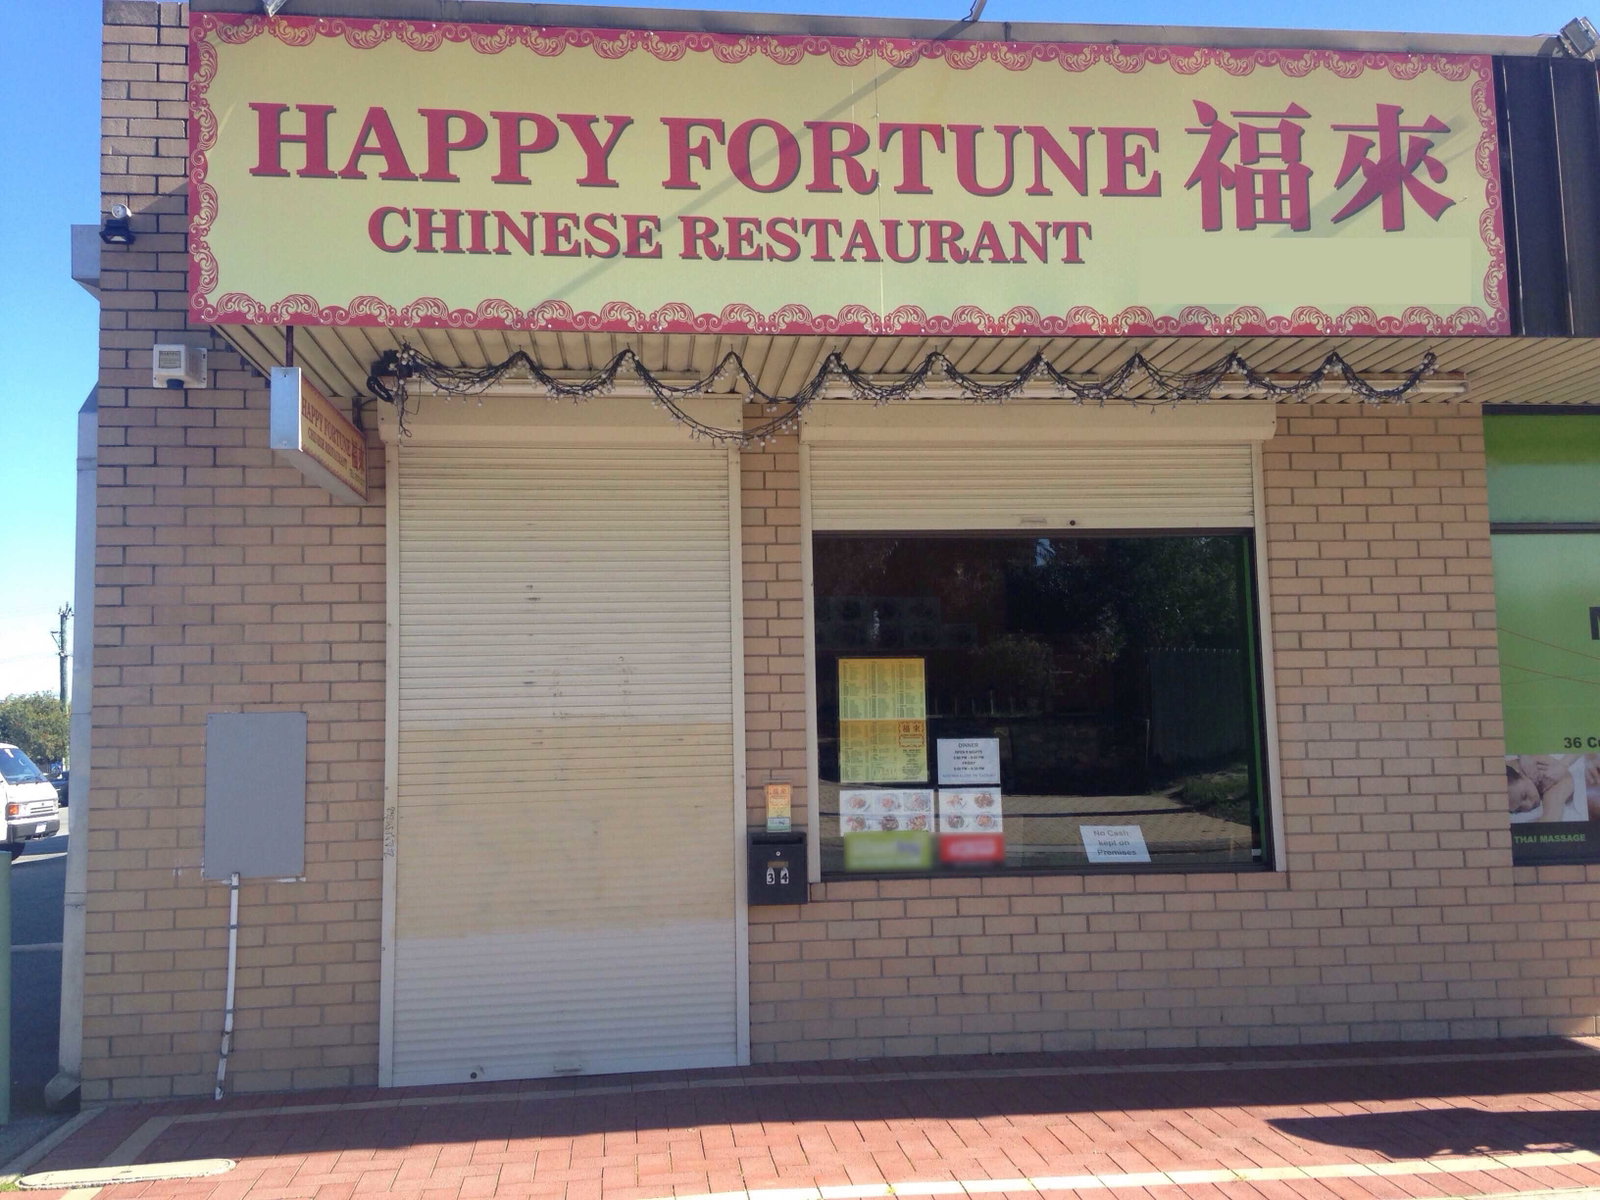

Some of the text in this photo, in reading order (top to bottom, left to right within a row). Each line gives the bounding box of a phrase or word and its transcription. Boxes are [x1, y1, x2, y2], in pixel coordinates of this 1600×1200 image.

[249, 102, 1162, 197] HAPPY FORTUNE
[1184, 100, 1457, 232] 福來
[368, 206, 1092, 265] CHINESE RESTAURANT
[1564, 737, 1600, 749] 36 C
[1514, 834, 1585, 843] THAI MASSAGE
